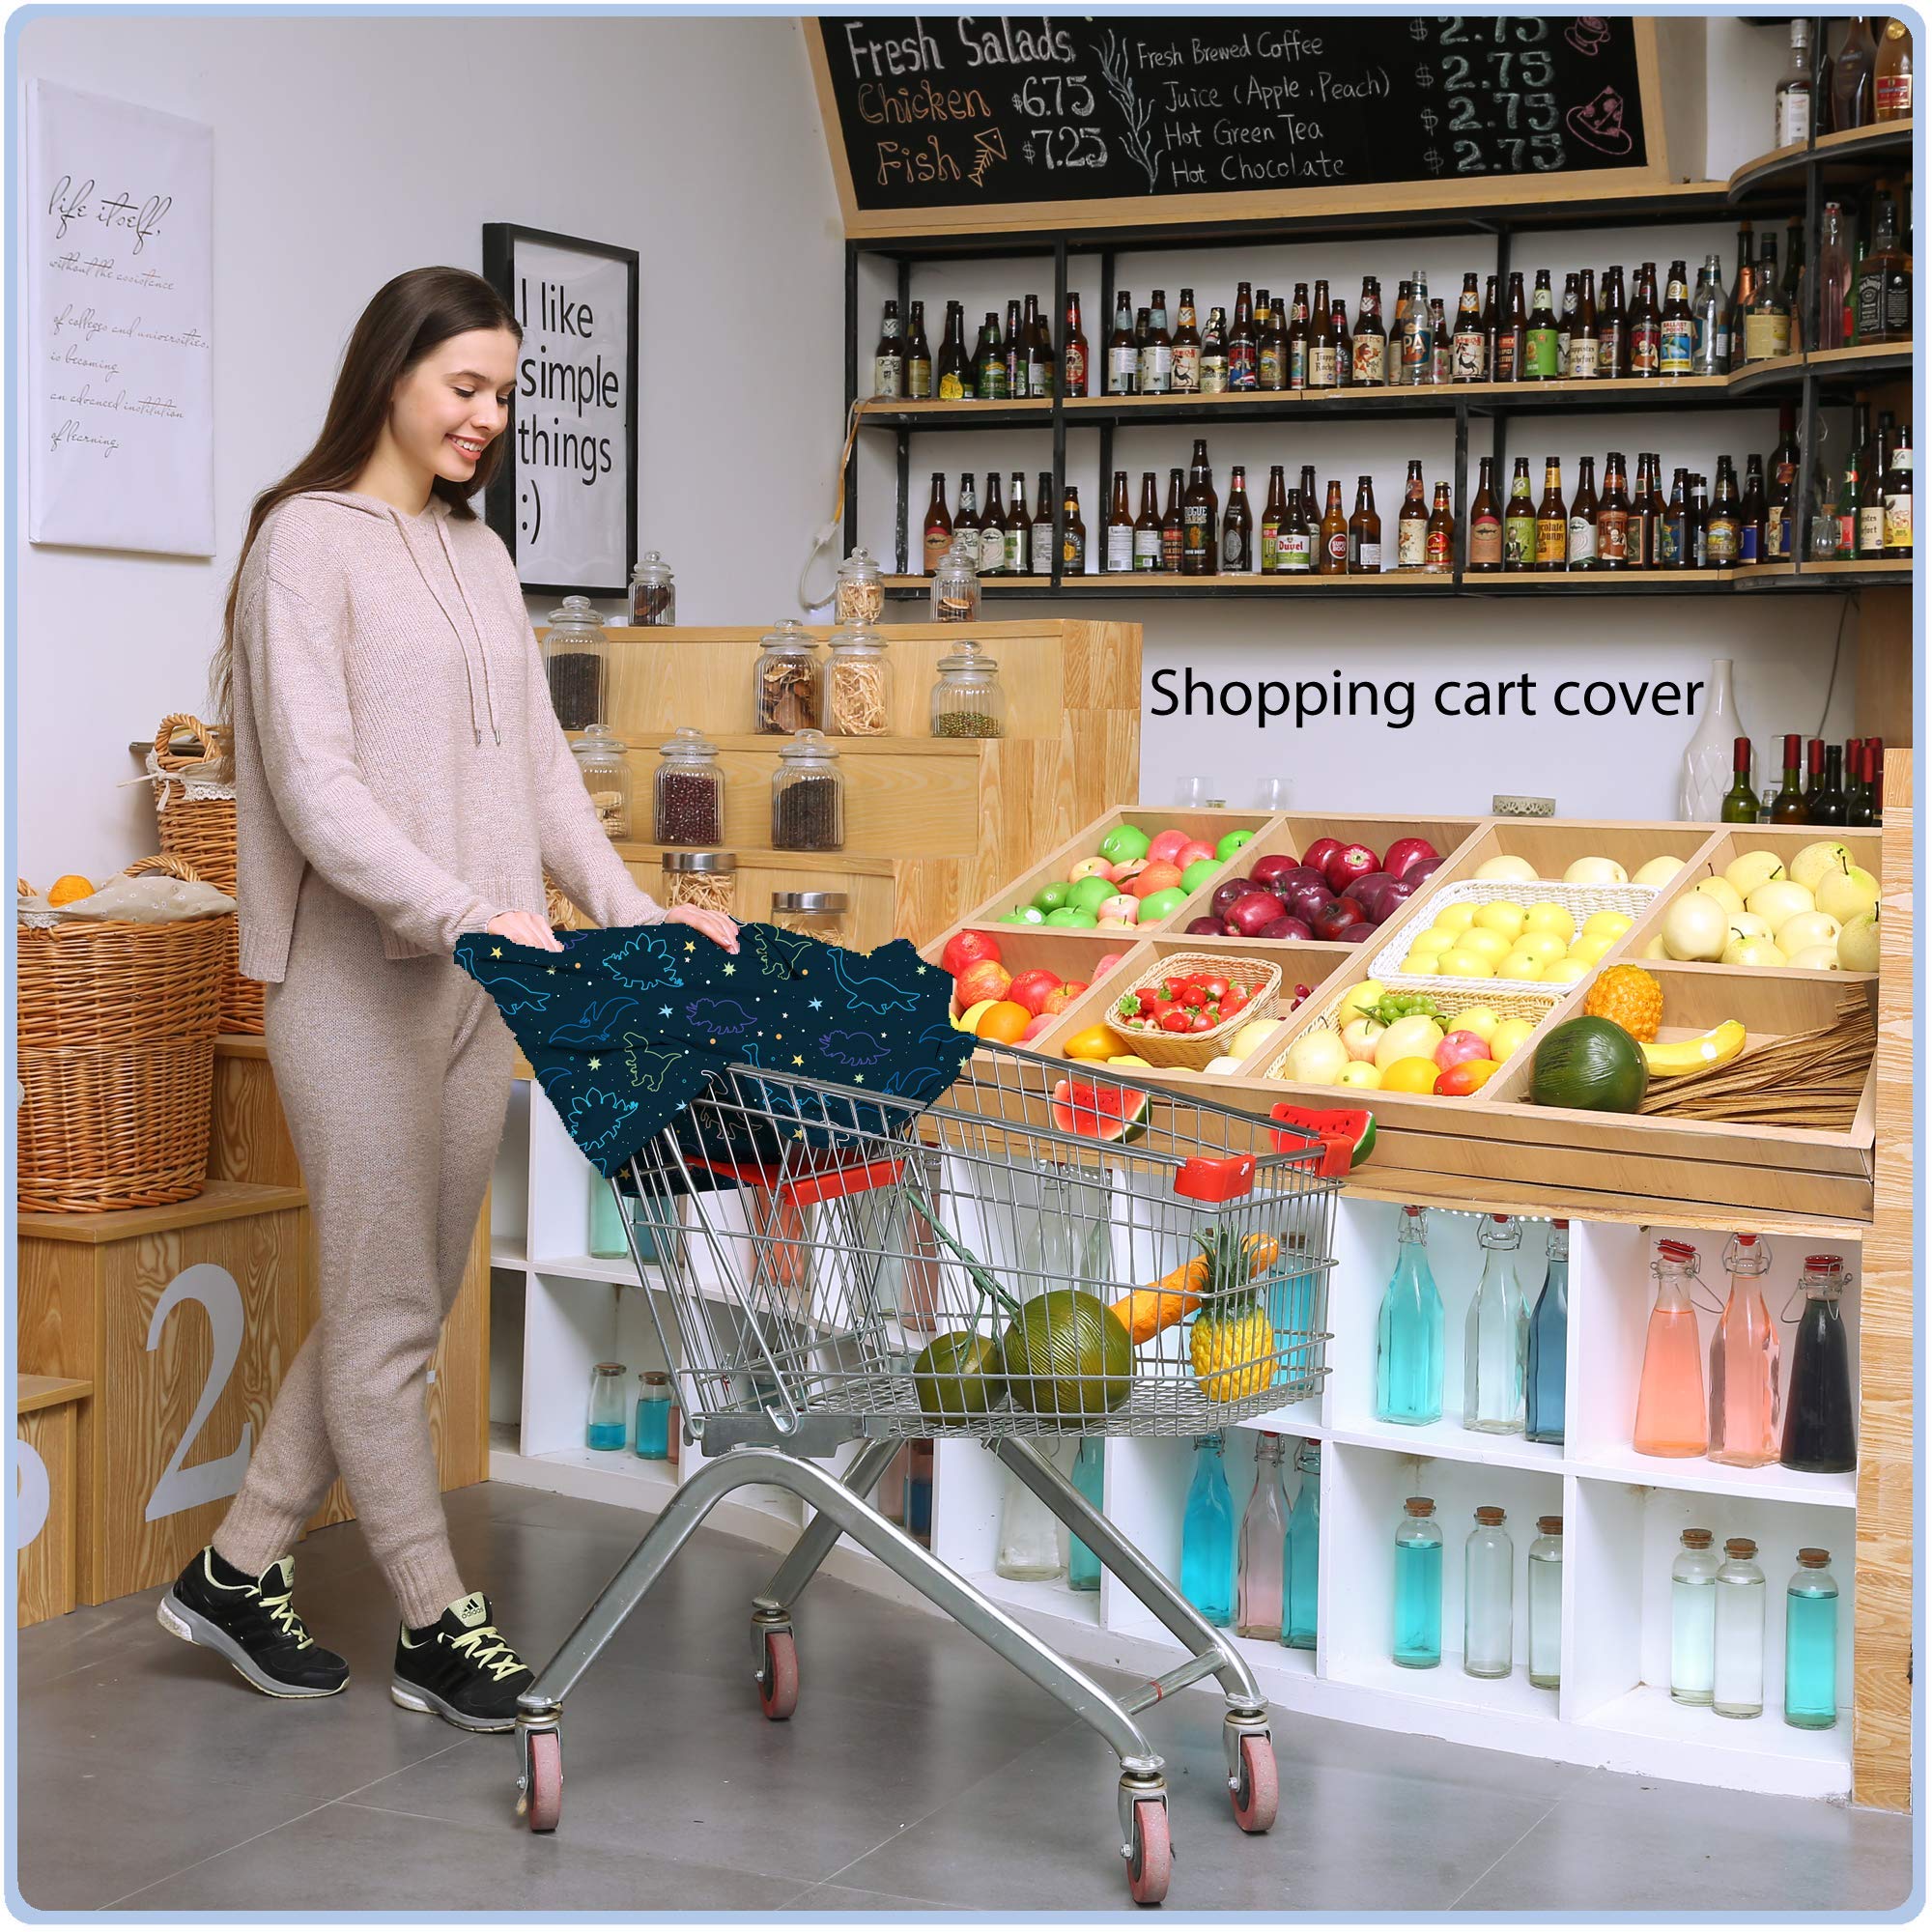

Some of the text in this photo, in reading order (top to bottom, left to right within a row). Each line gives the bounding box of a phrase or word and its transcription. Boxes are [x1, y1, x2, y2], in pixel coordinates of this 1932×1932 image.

[845, 17, 1076, 78] Fresh Salads
[1137, 29, 1323, 70] Fresh Brewed Coffee
[858, 79, 991, 124] Chicken
[1163, 81, 1223, 112] Juice
[1164, 114, 1324, 151] Hot Green Tea
[876, 134, 962, 185] Fish
[1171, 150, 1348, 187] Hot Chocolate
[48, 175, 96, 240] life
[48, 252, 98, 276] without
[95, 257, 115, 278] the
[53, 303, 73, 336] of
[68, 307, 108, 342] colleges
[111, 316, 142, 338] and
[521, 278, 594, 339] I like
[65, 343, 121, 384] becoming
[1403, 333, 1427, 356] PA
[70, 384, 127, 411] advanced
[123, 396, 185, 418] institution
[520, 345, 620, 418] simple
[50, 419, 73, 453] of
[517, 413, 612, 487] things
[1278, 541, 1304, 551] Duvel
[145, 1264, 251, 1521] 2
[461, 1607, 485, 1619] adidas
